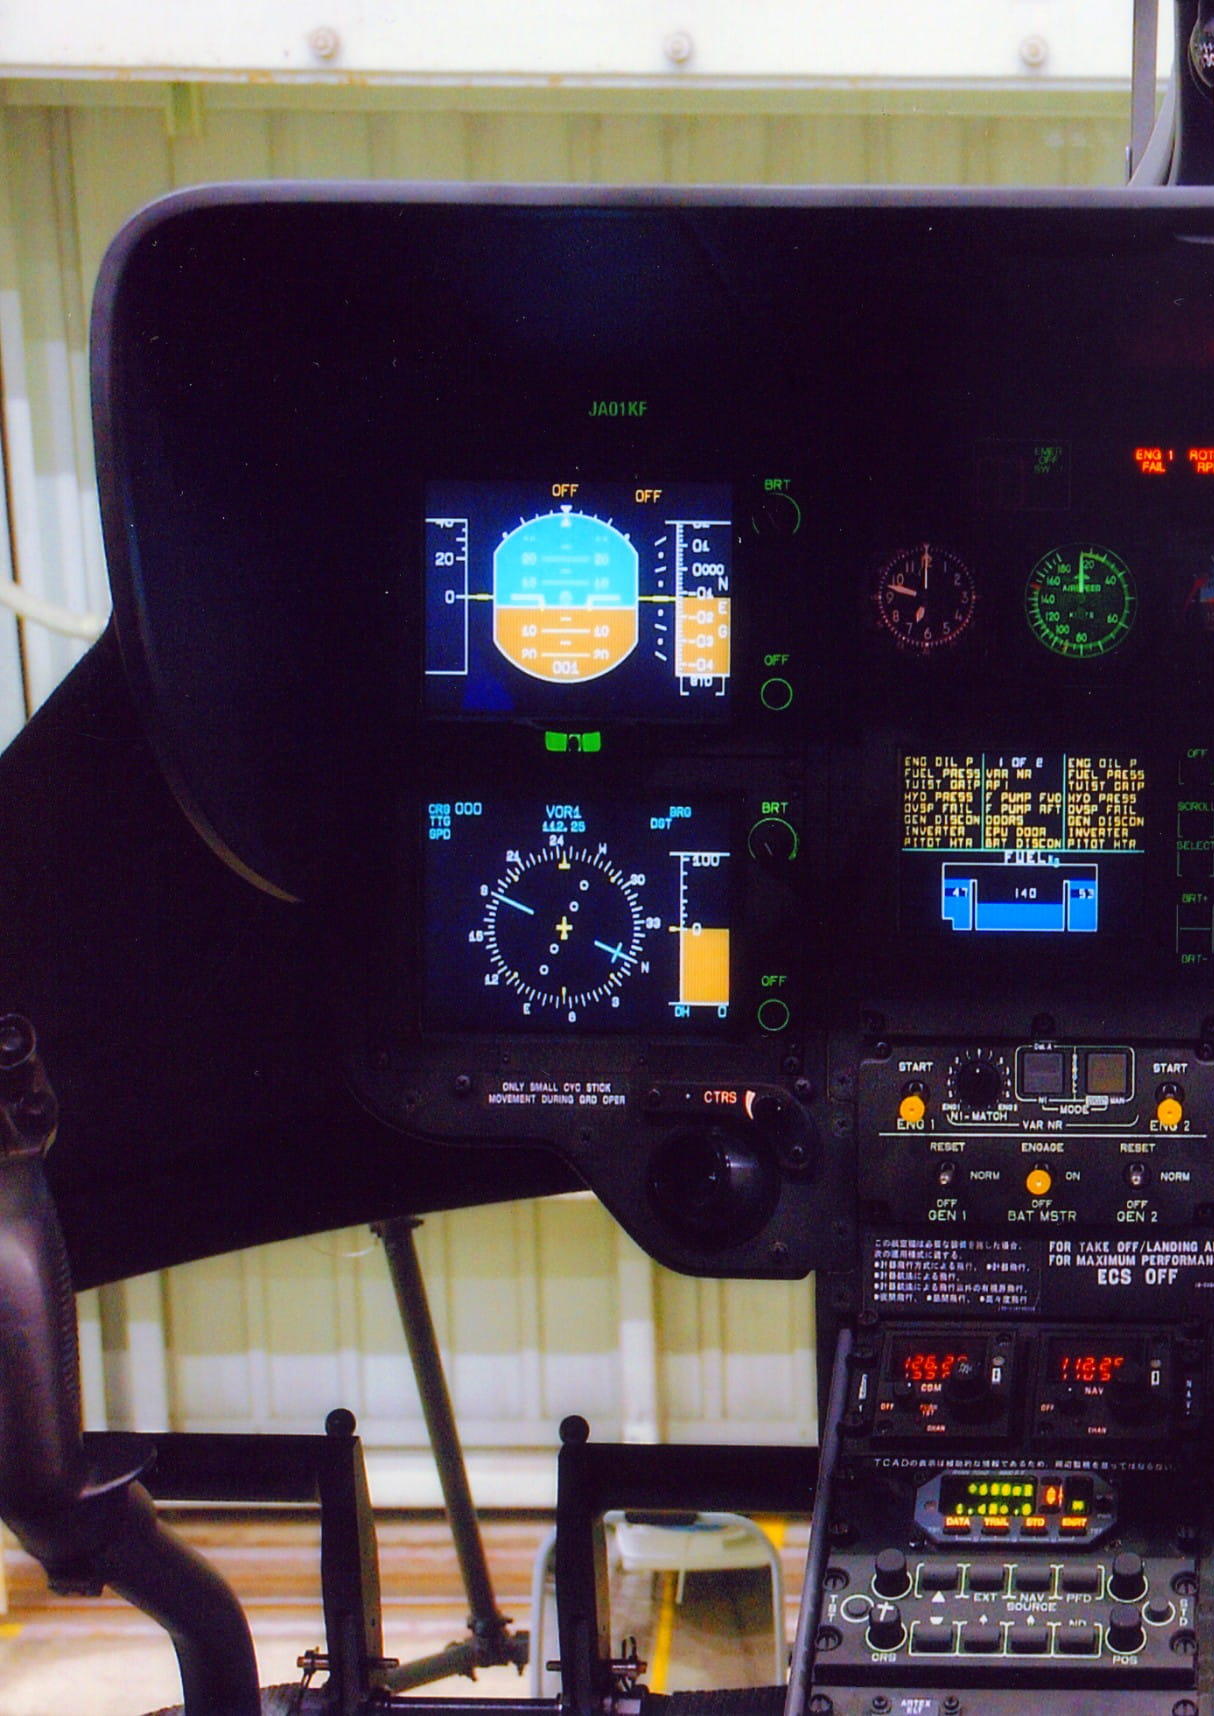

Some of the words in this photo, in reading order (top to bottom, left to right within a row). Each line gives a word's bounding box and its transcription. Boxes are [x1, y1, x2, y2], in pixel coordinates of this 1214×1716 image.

[588, 401, 648, 417] JA01KF
[1136, 449, 1161, 461] ENG
[1169, 450, 1173, 461] 1
[1142, 462, 1166, 473] FAIL
[764, 479, 791, 491] BRT
[551, 484, 579, 498] OFF
[634, 489, 663, 503] OFF
[764, 654, 789, 666] OFF
[904, 768, 934, 779] FUEL
[942, 769, 981, 779] PRESS
[1068, 769, 1098, 780] FUEL
[1107, 770, 1145, 781] PRESS
[904, 779, 942, 790] TWIST
[950, 780, 981, 791] GRIP
[1068, 780, 1105, 791] TWIST
[1114, 780, 1145, 792] GRIP
[904, 792, 927, 803] HYD
[935, 791, 973, 803] PRESS
[1068, 793, 1091, 804] HYD
[1098, 793, 1137, 804] PRESS
[545, 805, 582, 819] VOR1
[762, 801, 788, 814] BRT
[1068, 804, 1098, 815] OVSP
[1106, 805, 1136, 815] FAIL
[430, 816, 451, 827] TTG
[904, 814, 927, 825] GEN
[935, 815, 980, 826] DISCON
[985, 815, 1024, 826] DOORS
[1068, 816, 1091, 827] GEN
[1099, 816, 1145, 827] DISCON
[542, 821, 586, 833] 112.25
[905, 826, 966, 837] INVERTER
[1068, 827, 1129, 838] INVERTER
[549, 835, 564, 846] 24
[904, 837, 941, 849] PITOT
[950, 838, 973, 849] HTR
[985, 838, 1008, 849] BAT
[1015, 838, 1062, 849] DISCON
[1068, 838, 1105, 849] PITOT
[1114, 839, 1137, 850] HTR
[1015, 888, 1037, 899] 140
[761, 975, 787, 987] OFF
[899, 1062, 933, 1073] START
[1153, 1063, 1188, 1073] START
[502, 1082, 526, 1093] ONLY
[530, 1082, 559, 1093] SMALL
[563, 1082, 582, 1093] CYC
[586, 1083, 611, 1094] STICK
[489, 1094, 537, 1105] MOVEMENT
[541, 1094, 575, 1105] DURING
[579, 1094, 598, 1105] GRD
[602, 1094, 625, 1105] OPER
[704, 1091, 737, 1104] CTRS
[1060, 1105, 1089, 1115] MODE
[1022, 1120, 1045, 1130] VAR
[1047, 1120, 1063, 1130] NR
[930, 1142, 965, 1152] RESET
[1021, 1143, 1064, 1152] ENGAGE
[1120, 1143, 1156, 1153] RESET
[970, 1171, 1000, 1180] NORM
[1066, 1171, 1080, 1181] ON
[1160, 1172, 1190, 1182] NORM
[937, 1199, 958, 1208] OFF
[1032, 1200, 1052, 1208] OFF
[1127, 1200, 1148, 1209] OFF
[928, 1210, 956, 1221] GEN
[963, 1210, 967, 1222] 1
[1007, 1210, 1036, 1222] BAT
[1040, 1211, 1077, 1222] MSTR
[1117, 1211, 1145, 1222] GEN
[1151, 1211, 1158, 1222] 2
[1049, 1241, 1071, 1253] FOR
[1079, 1241, 1110, 1253] TAKE
[1117, 1241, 1199, 1253] OFF/LANDING
[1049, 1255, 1071, 1266] FOR
[1076, 1255, 1137, 1266] MAXIMUM
[1098, 1269, 1132, 1285] ECS
[1145, 1269, 1178, 1285] OFF
[1085, 1386, 1104, 1395] NAV
[945, 1517, 971, 1527] DATA
[973, 1592, 997, 1603] EXT
[1019, 1593, 1044, 1603] NAV
[1006, 1602, 1057, 1612] SOURCE
[871, 1653, 896, 1662] CRS
[1112, 1655, 1138, 1665] POS
